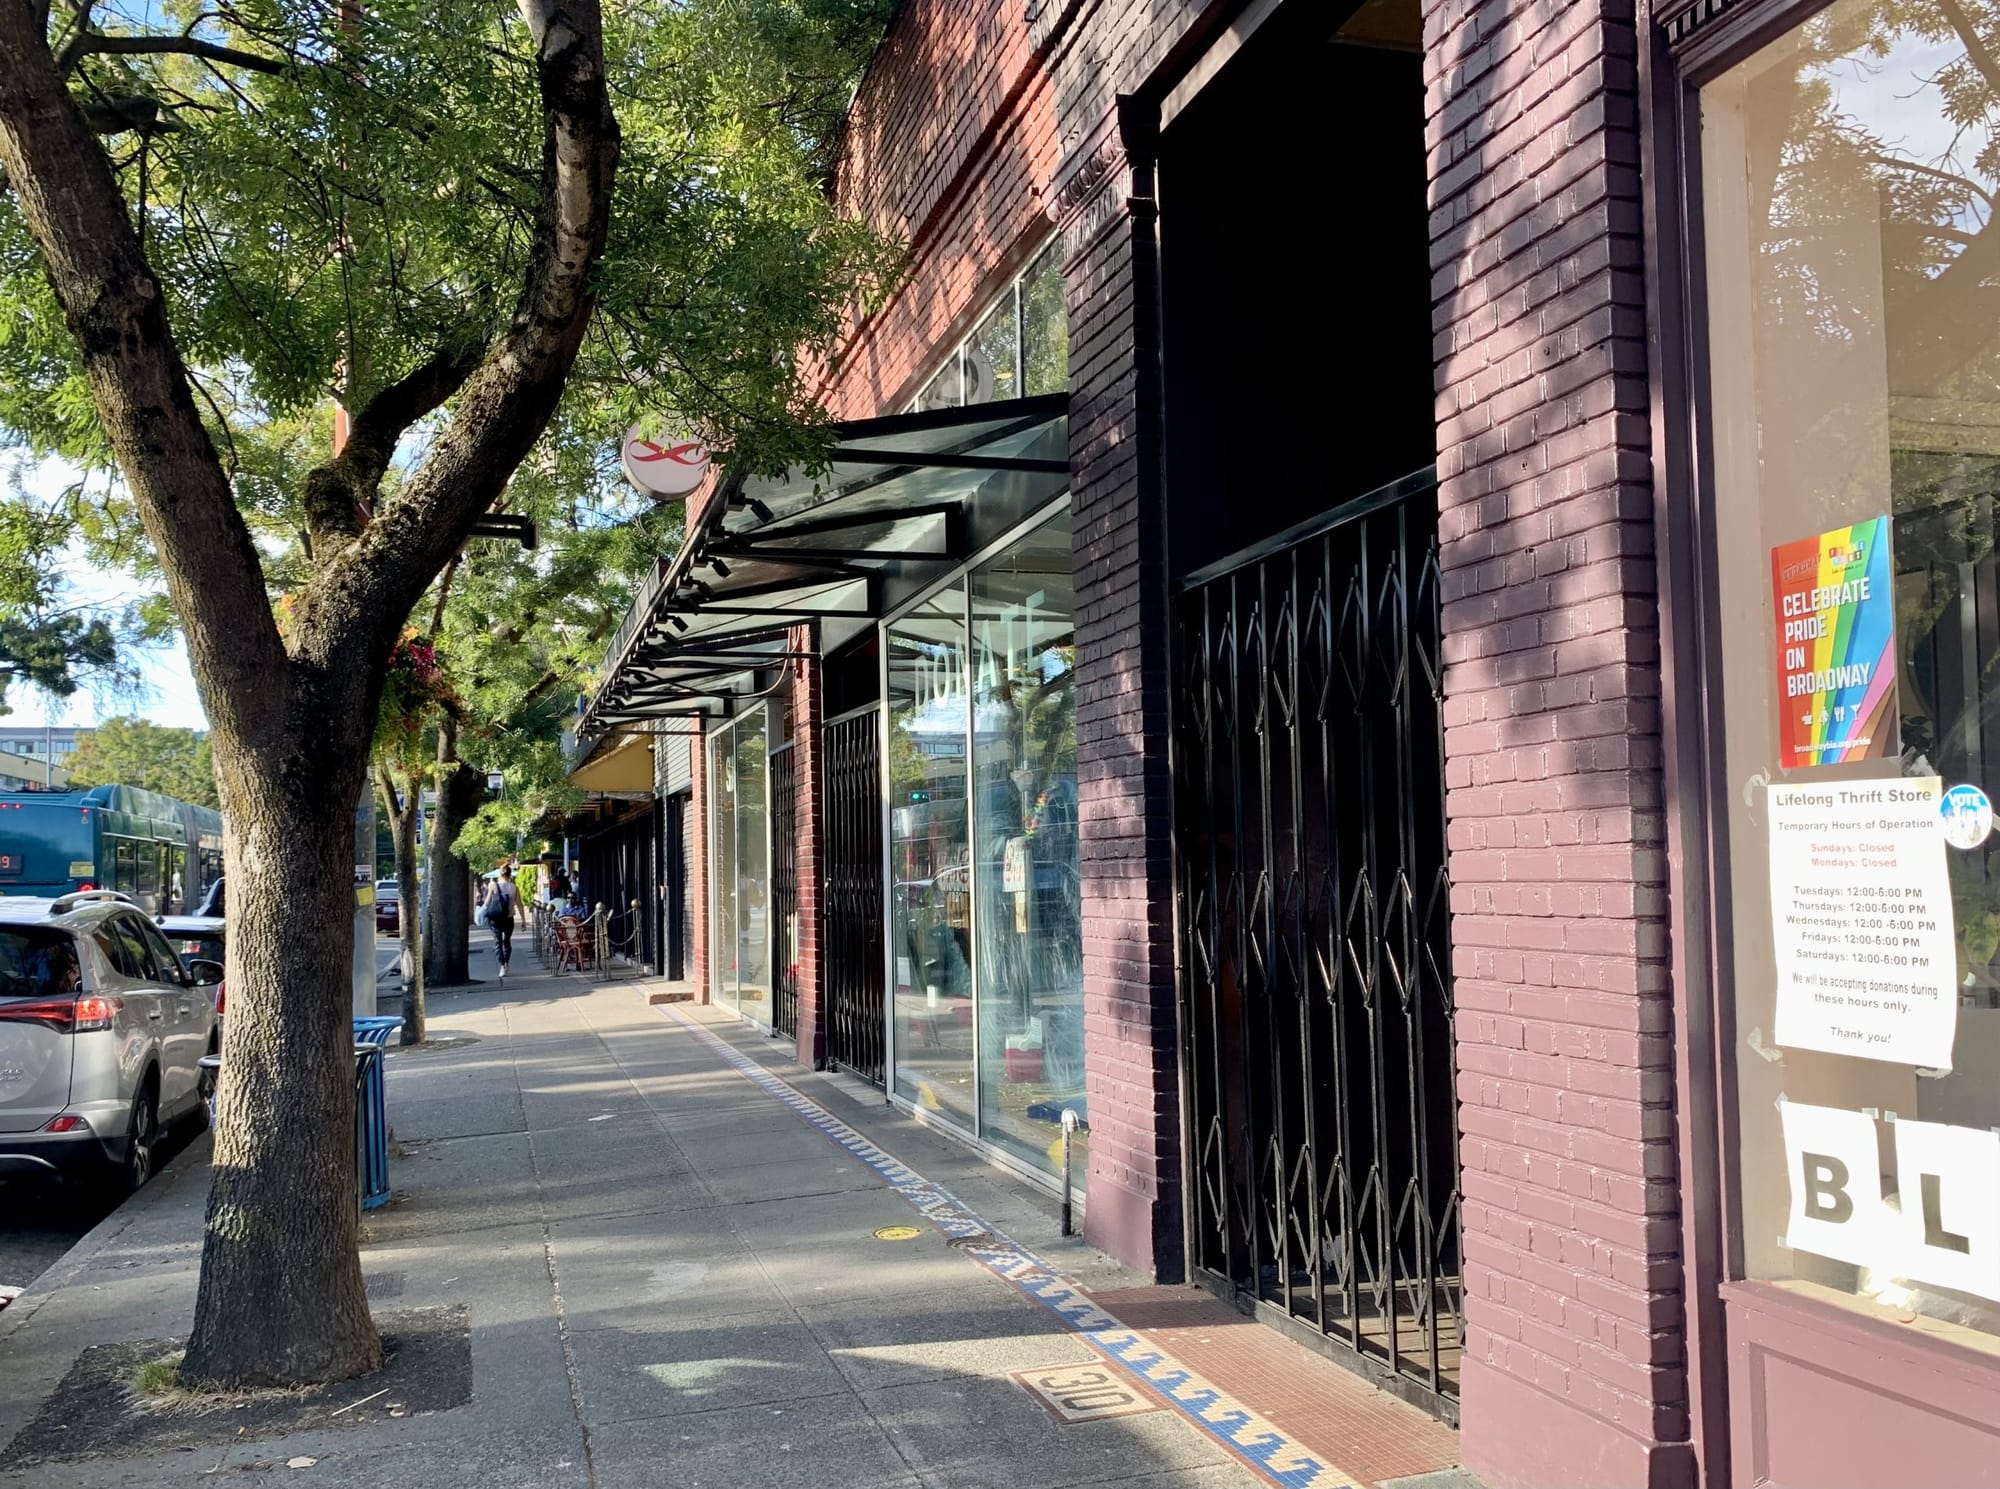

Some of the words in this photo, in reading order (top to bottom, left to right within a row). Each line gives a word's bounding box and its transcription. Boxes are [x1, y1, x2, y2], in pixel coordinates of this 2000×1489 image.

[1783, 577, 1871, 617] CELEBRATE
[1784, 614, 1828, 644] PRIDE
[914, 588, 1045, 718] DONATE
[1786, 646, 1805, 670] ON
[1787, 661, 1870, 697] BROADWAY
[1776, 794, 1833, 807] Lifelong
[1839, 791, 1882, 804] Thrift
[1888, 789, 1932, 802] Store
[1778, 822, 1828, 832] Temporary
[1832, 821, 1862, 830] Hours
[1865, 820, 1876, 829] of
[1879, 819, 1934, 830] Operation
[1811, 843, 1856, 854] Sundays:
[1858, 843, 1895, 852] Closed
[1811, 858, 1858, 869] Mondays:
[1861, 858, 1897, 867] Closed
[1794, 886, 1844, 898] Tuesdays:
[1847, 887, 1901, 898] 12:00-6:00
[1905, 888, 1922, 898] PM
[1793, 901, 1846, 913] Thursdays:
[1850, 903, 1905, 914] 12:00-6:00
[1909, 904, 1926, 914] PM
[1786, 915, 1850, 928] Wednesdays:
[1918, 921, 1936, 931] PM
[1801, 932, 1841, 944] Fridays:
[1844, 934, 1899, 946] 12:00-6:00
[1903, 937, 1920, 947] PM
[1796, 949, 1848, 962] Saturdays:
[1852, 953, 1907, 966] 12:00-6:00
[1912, 957, 1929, 967] PM
[1792, 972, 1803, 984] We
[1805, 974, 1817, 985] will
[1819, 975, 1828, 986] be
[1830, 976, 1867, 993] accepting
[1869, 979, 1909, 994] donations
[1911, 983, 1938, 1000] during
[1814, 993, 1844, 1005] these
[1848, 996, 1879, 1008] hours
[1883, 1000, 1911, 1013] only.
[1830, 1026, 1864, 1040] Thank
[1867, 1033, 1891, 1044] you!
[1039, 1372, 1135, 1410] 310
